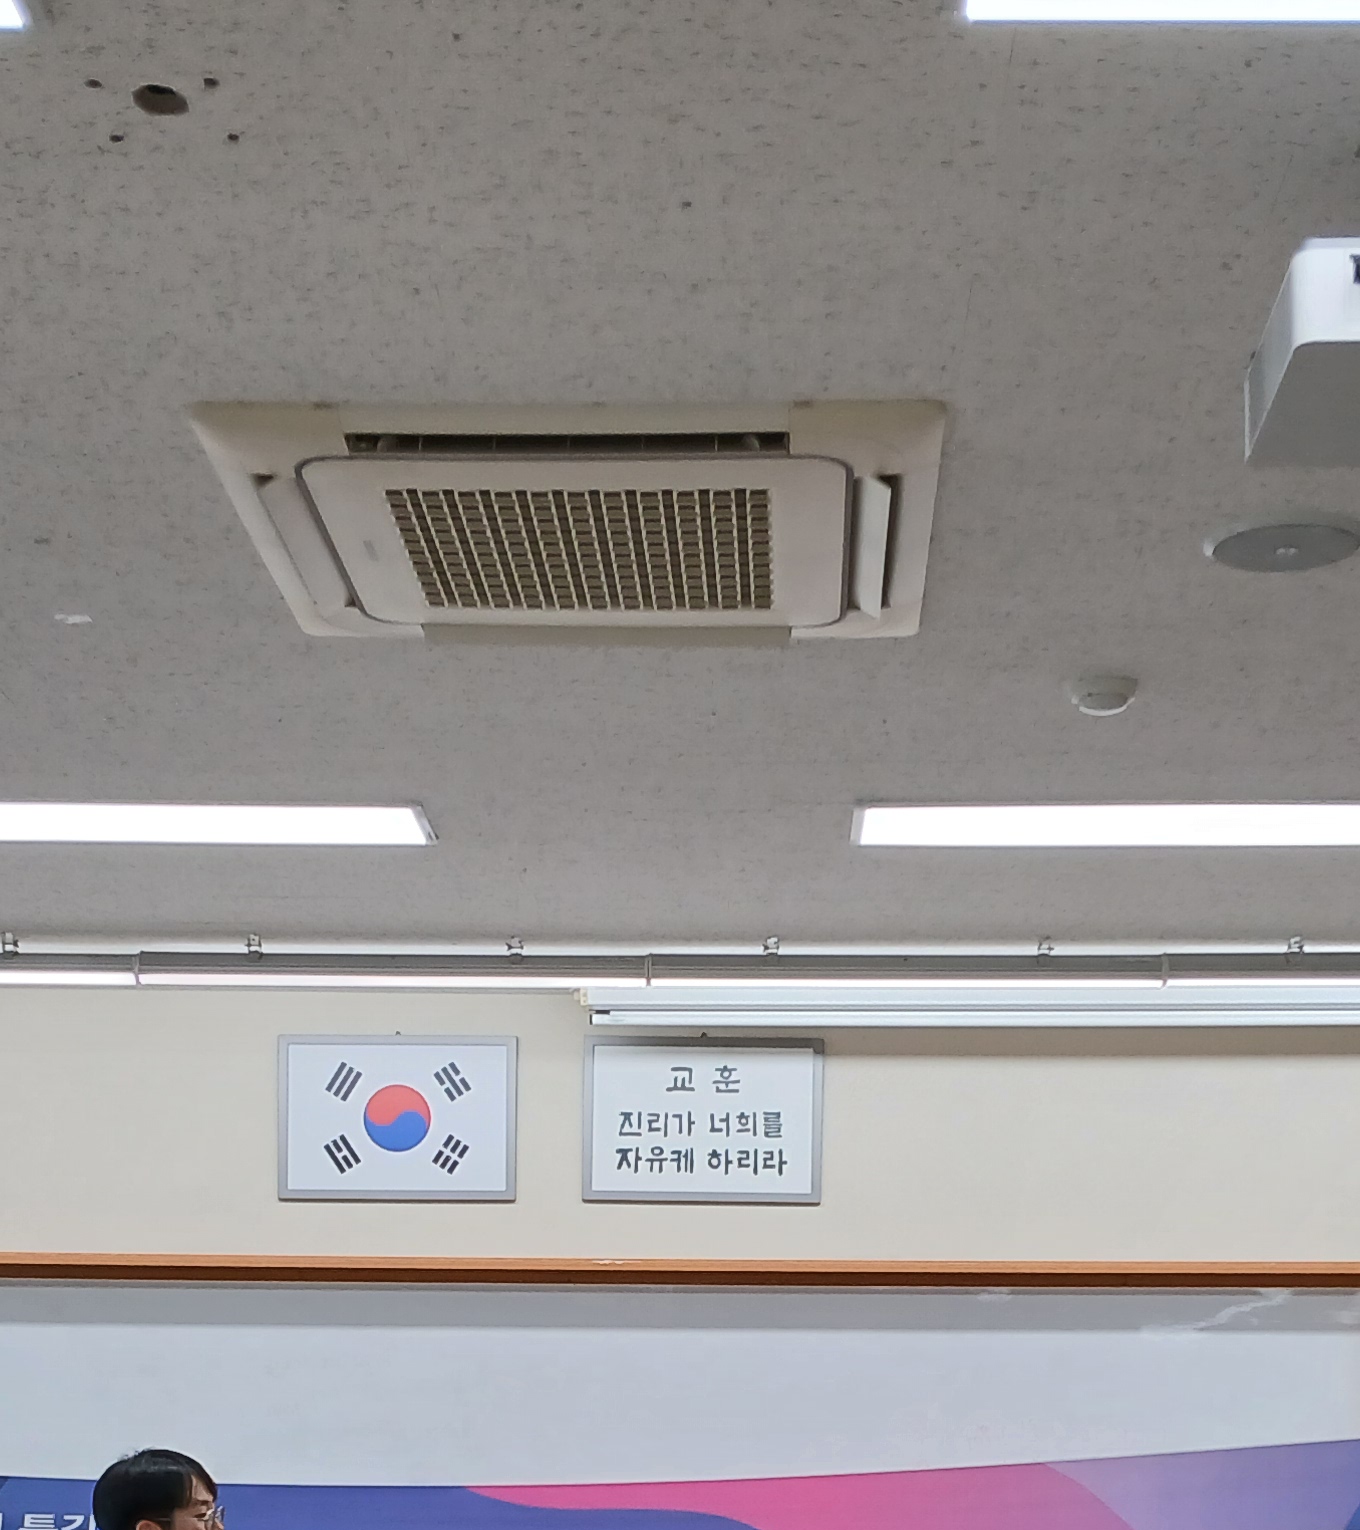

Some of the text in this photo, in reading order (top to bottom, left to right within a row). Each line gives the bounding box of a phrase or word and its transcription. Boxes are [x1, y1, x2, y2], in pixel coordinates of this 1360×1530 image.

[665, 1064, 741, 1093] 교 훈
[618, 1109, 785, 1139] 진리가 너희를
[615, 1146, 788, 1176] 자유케 하리라
